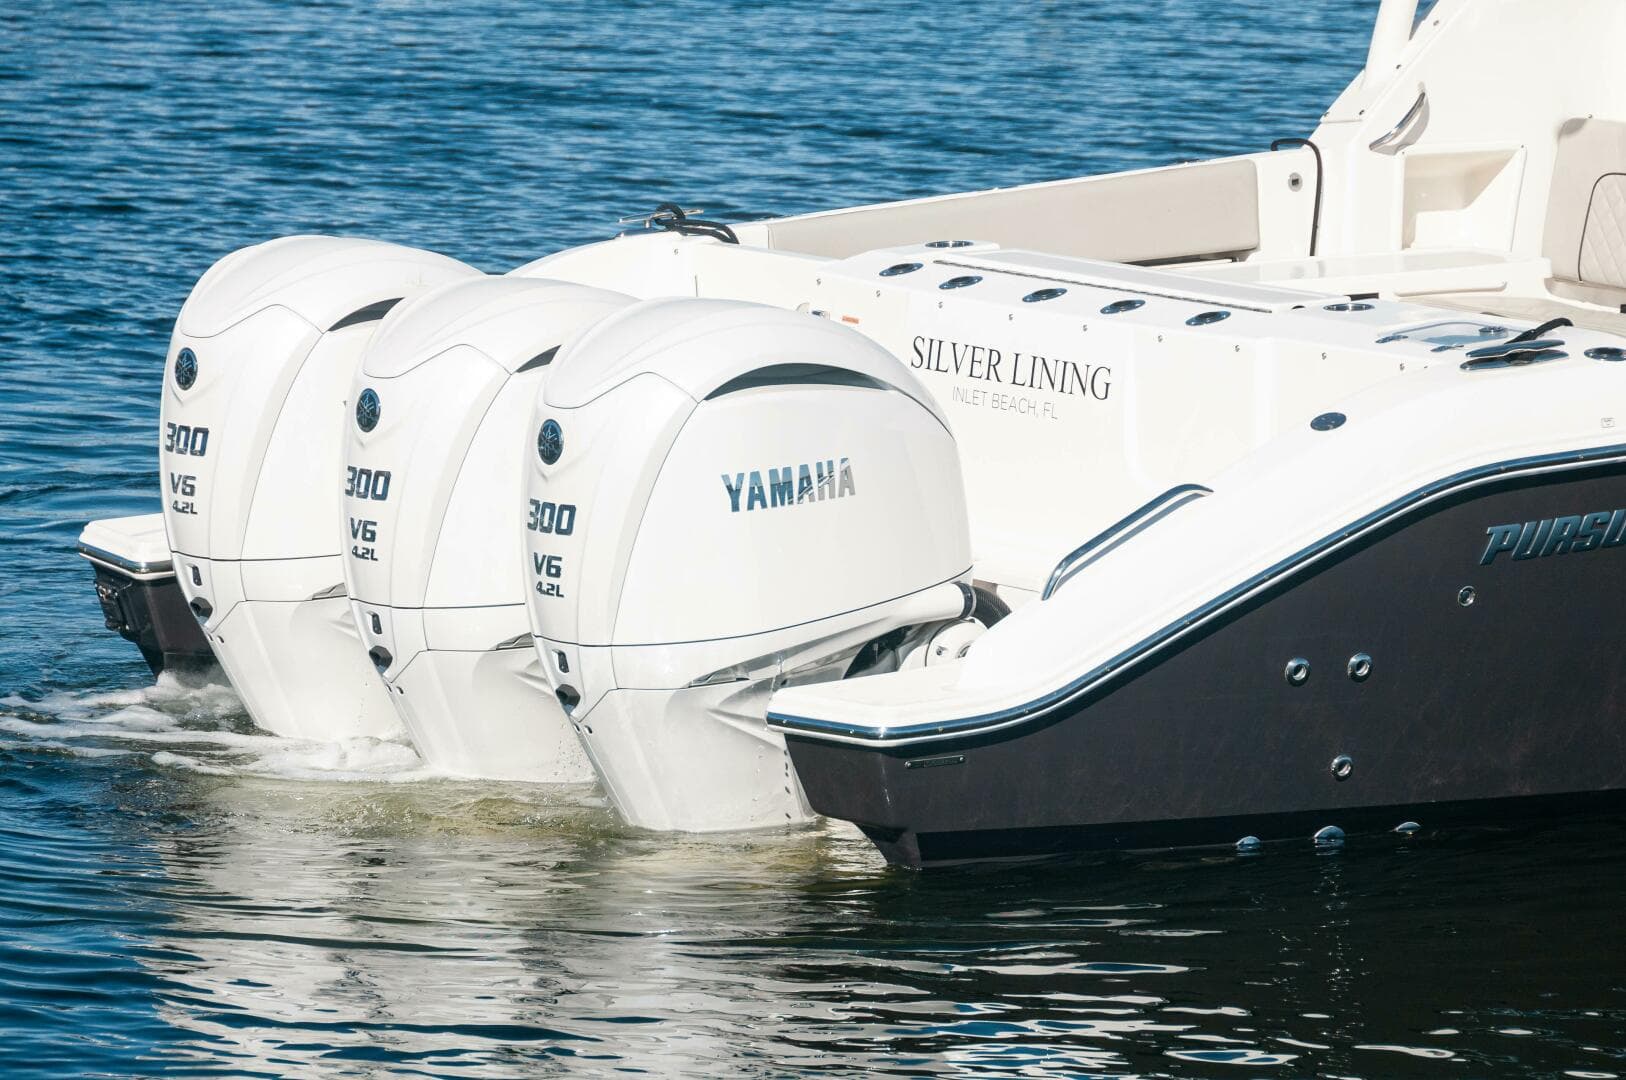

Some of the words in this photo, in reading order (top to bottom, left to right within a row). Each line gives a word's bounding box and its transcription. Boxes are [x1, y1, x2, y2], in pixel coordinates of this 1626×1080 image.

[911, 335, 1002, 383] SILVER
[1011, 353, 1111, 401] LINING
[952, 386, 988, 407] INLET
[991, 393, 1039, 418] BEACH,
[1043, 402, 1058, 420] FL
[165, 422, 209, 456] 300
[170, 472, 196, 497] V6
[345, 465, 391, 501] 300
[721, 457, 856, 512] YAMAHA
[172, 500, 198, 515] 4.2L
[527, 498, 576, 536] 300
[350, 517, 377, 542] V6
[352, 545, 378, 561] 4.2L
[533, 552, 562, 578] V6
[536, 581, 564, 598] 4.2L
